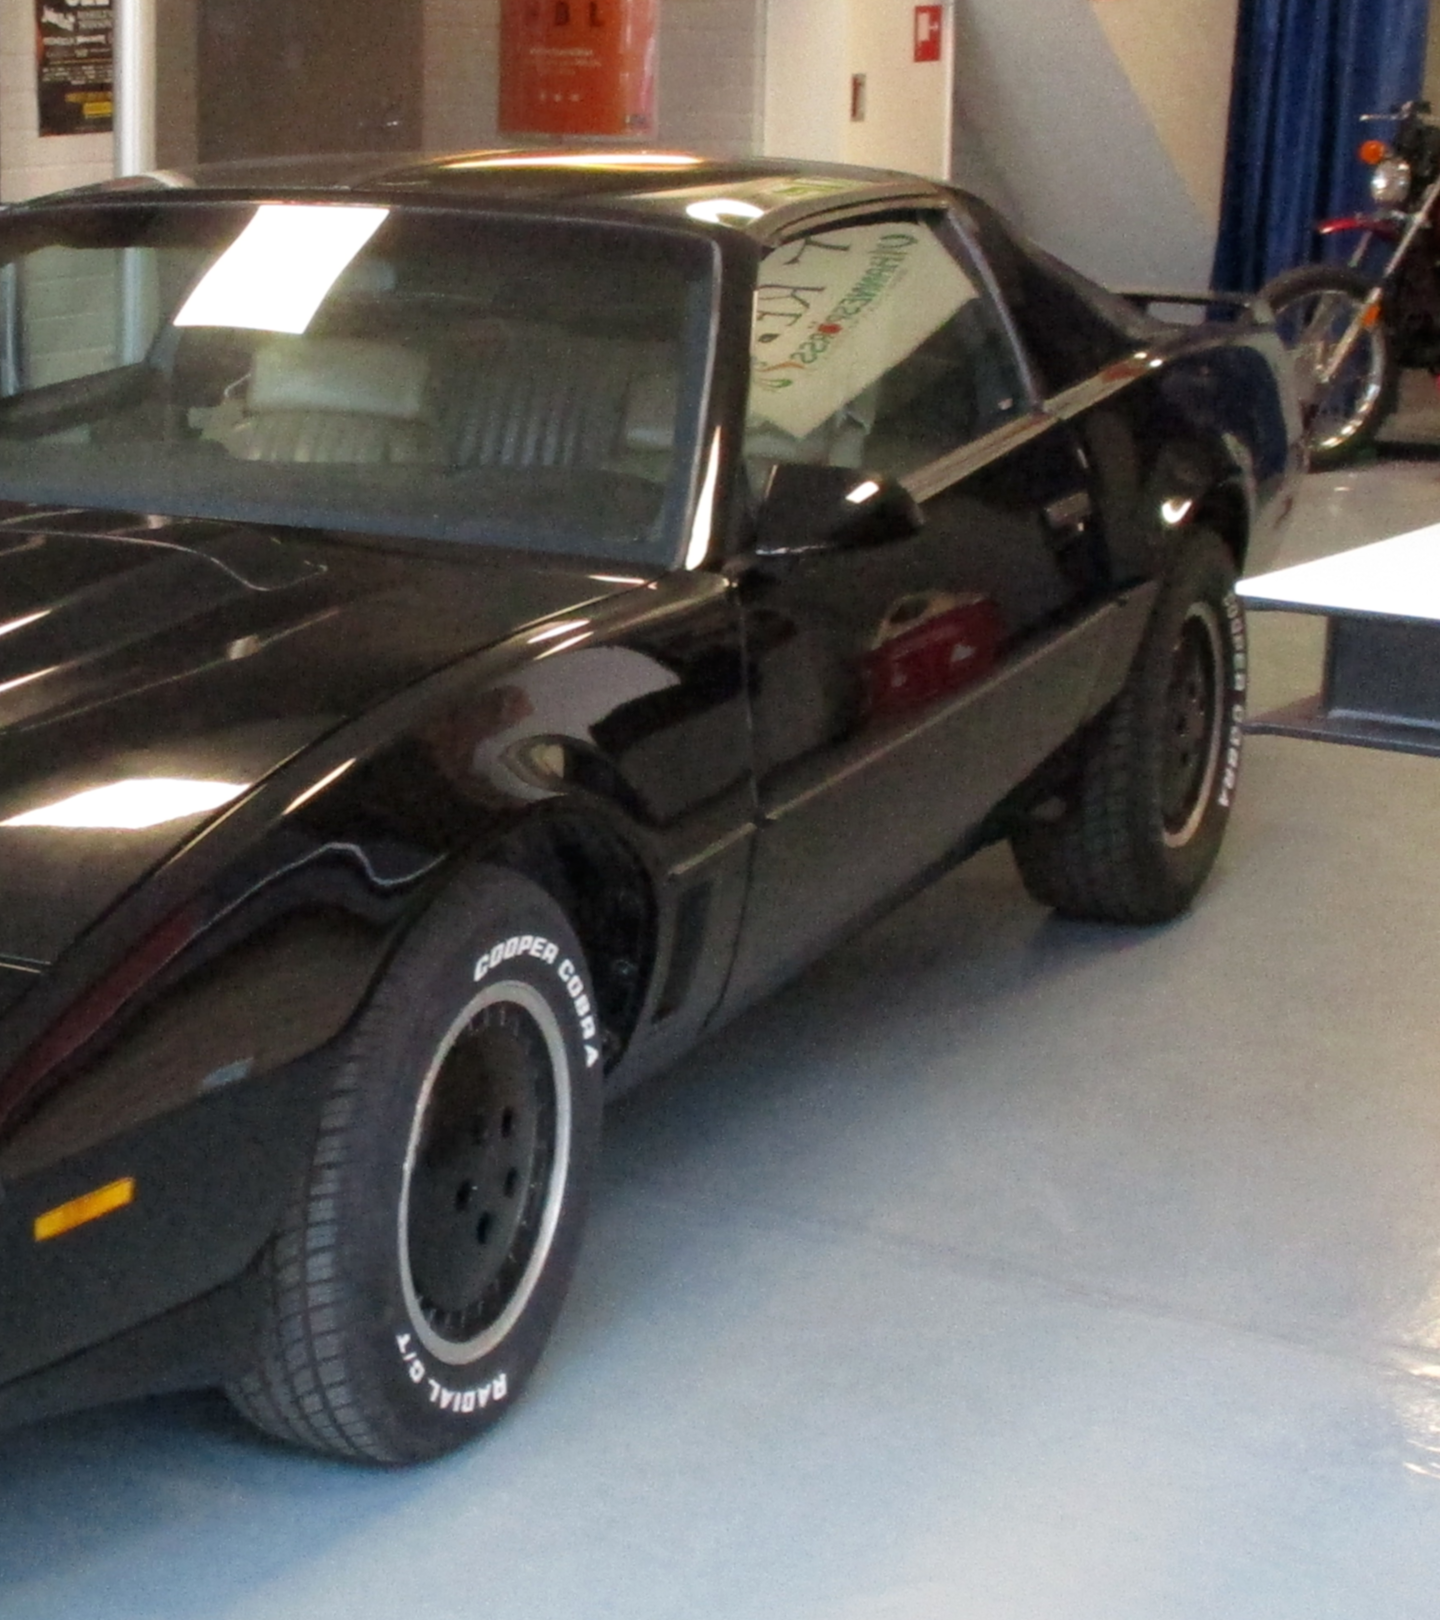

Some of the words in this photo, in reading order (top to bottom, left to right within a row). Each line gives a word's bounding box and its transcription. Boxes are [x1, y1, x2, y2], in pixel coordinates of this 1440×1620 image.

[473, 934, 560, 982] COOPER
[558, 958, 600, 1068] COBRA
[428, 1372, 508, 1413] RADIAL
